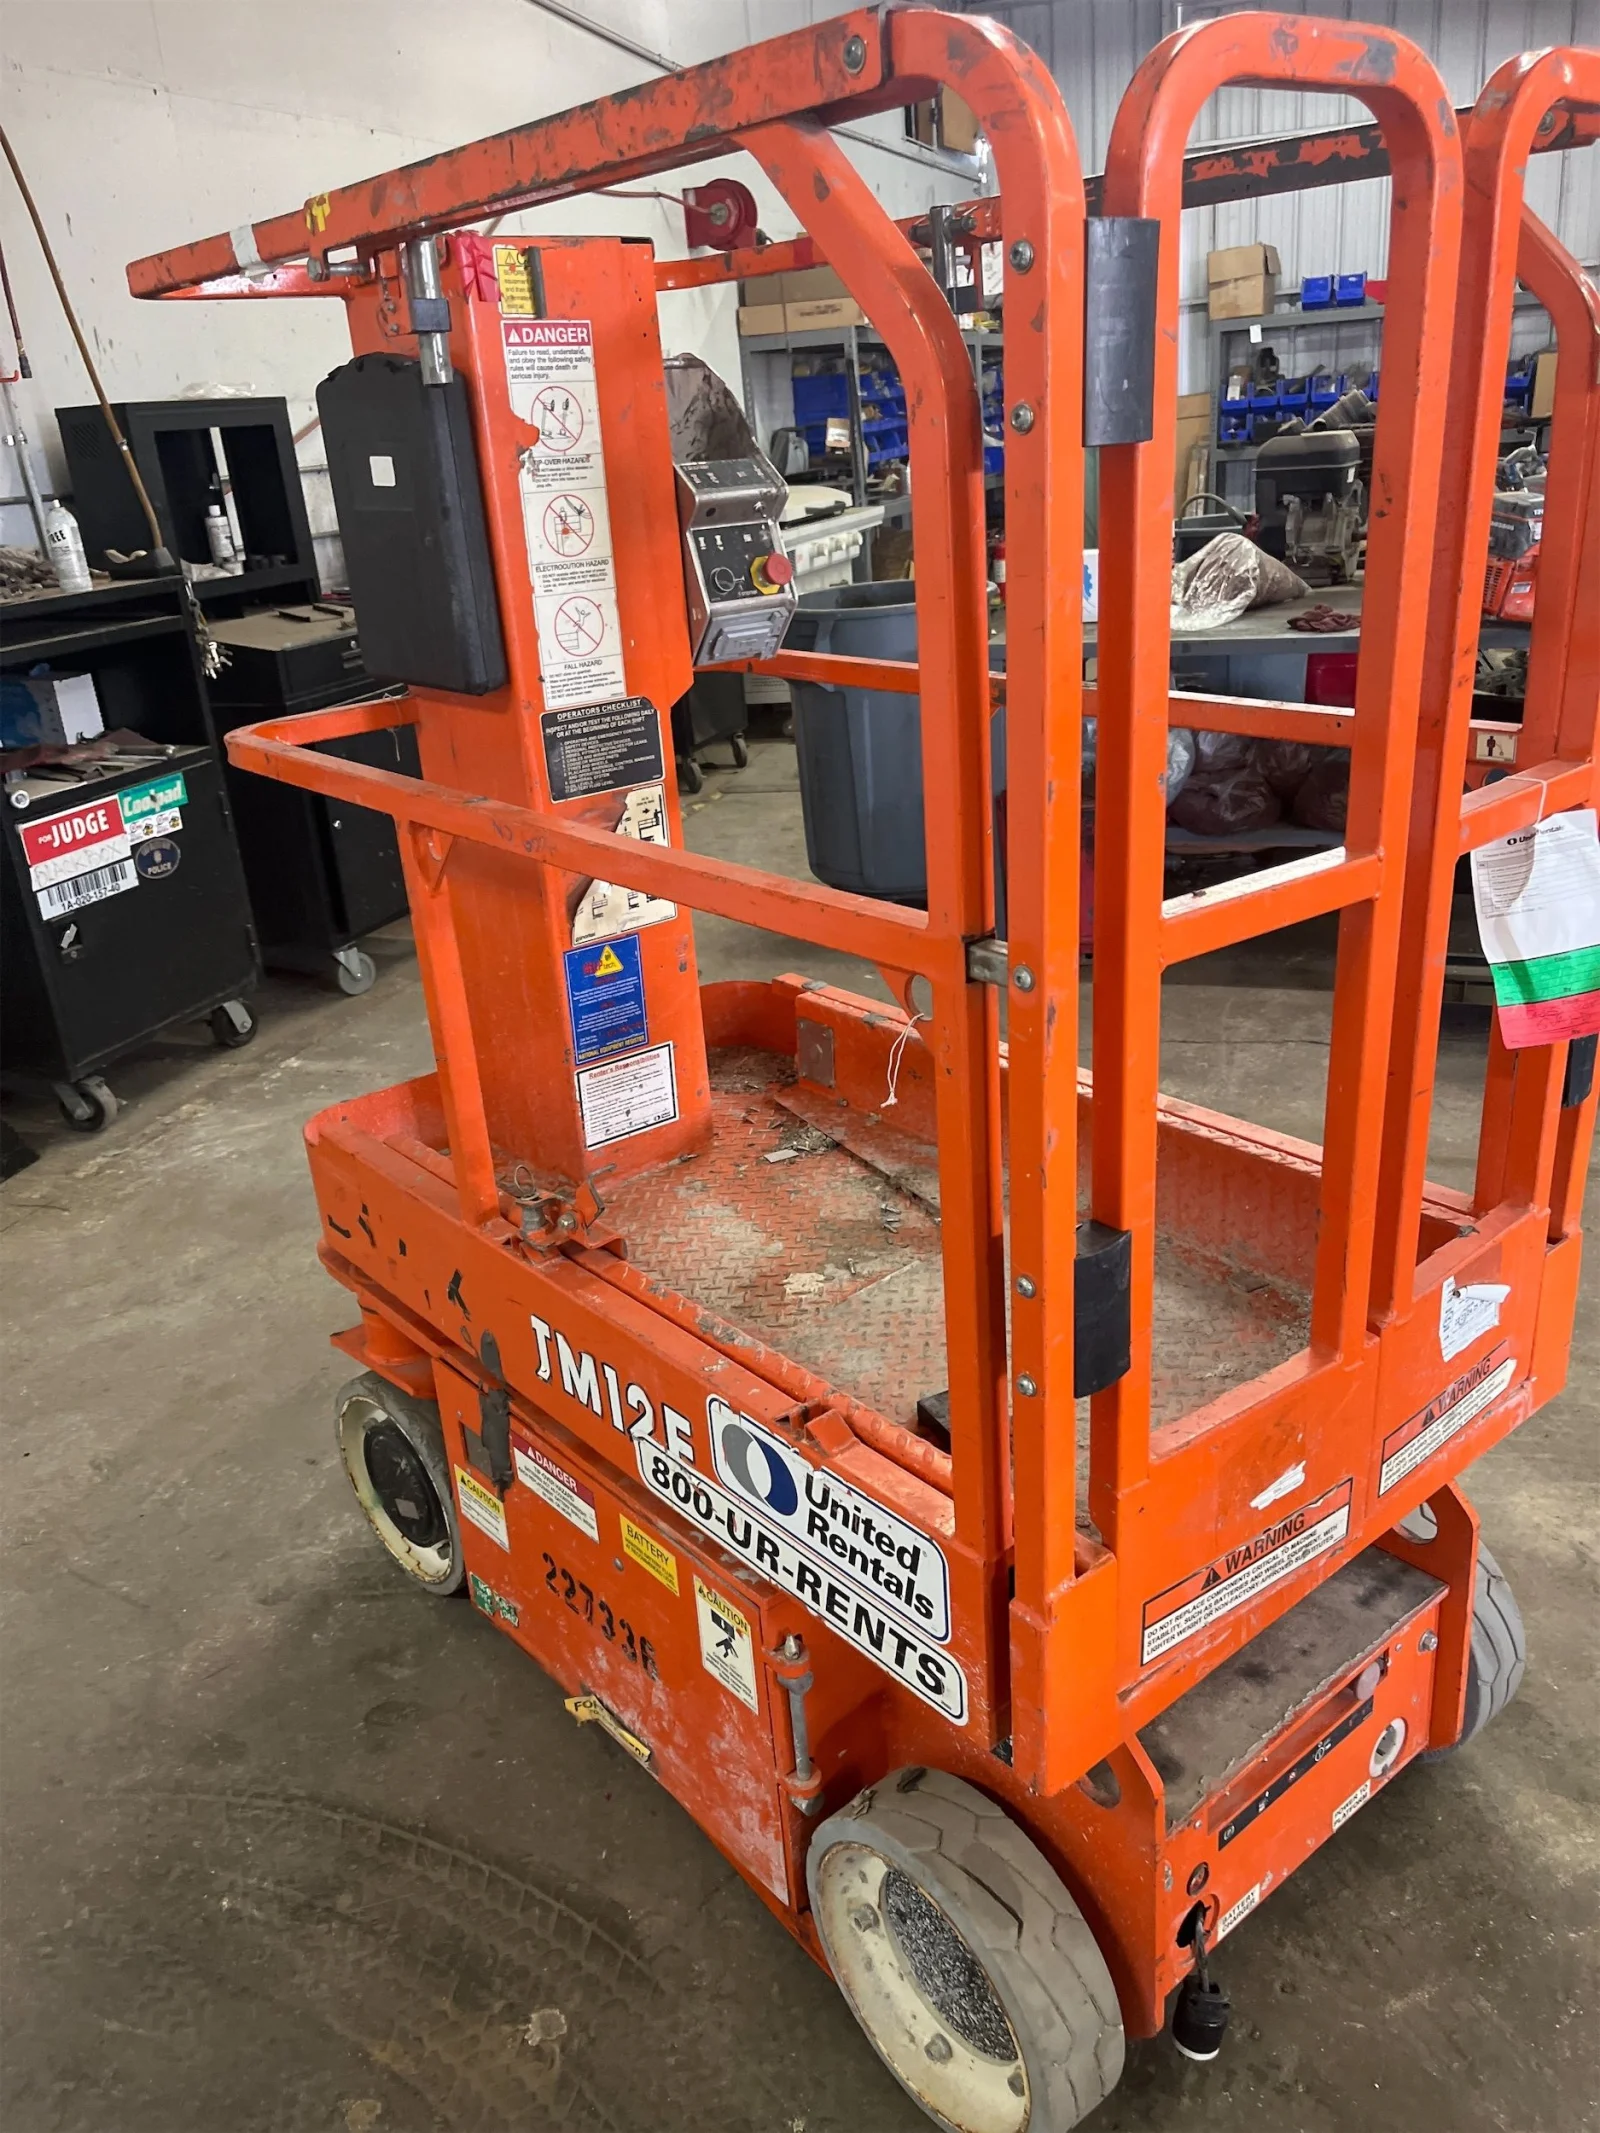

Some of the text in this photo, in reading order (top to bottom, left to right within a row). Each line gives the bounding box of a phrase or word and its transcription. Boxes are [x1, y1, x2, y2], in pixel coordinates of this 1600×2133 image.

[522, 328, 588, 343] DANGER
[535, 559, 609, 573] ELECTROCUTION HAZARD
[579, 659, 603, 668] HAZARD
[546, 725, 568, 734] INSPECT
[568, 722, 587, 730] AND/OR
[612, 712, 640, 721] FOLLOWING
[557, 700, 641, 720] OPERATORS CHECKLIST
[583, 723, 609, 733] BEGINNING
[38, 834, 52, 844] FOR
[51, 809, 109, 848] JUDGE
[148, 862, 172, 875] POLICE
[62, 883, 121, 911] 1A-020-157-40
[589, 1066, 613, 1080] Renter's
[1438, 1358, 1490, 1413] WARNING
[535, 1450, 578, 1492] DANGER
[466, 1480, 500, 1513] CAUTION
[804, 1471, 920, 1576] United
[627, 1524, 669, 1565] BATTERY
[1225, 1514, 1305, 1573] WARNING
[652, 1456, 947, 1697] 800-UR-RENTS
[807, 1510, 934, 1622] Rentals
[1184, 1608, 1203, 1625] SUCH
[1204, 1602, 1213, 1613] AS
[1214, 1579, 1249, 1606] BATTERIES
[1251, 1570, 1263, 1583] AND
[1265, 1557, 1284, 1574] WHEEL
[1324, 1524, 1338, 1537] WITH
[1147, 1529, 1317, 1640] DO NOT REPLACE COMPONENTS CRITICAL TO MACHINE
[706, 1591, 748, 1632] CAUTION
[1146, 1633, 1176, 1657] LIGHTER
[1177, 1616, 1202, 1638] WEIGHT
[1203, 1609, 1213, 1621] OR
[1215, 1581, 1259, 1614] NON-FACTORY
[1261, 1559, 1293, 1585] APPROVED
[1333, 1792, 1368, 1826] PLATFORM
[1334, 1784, 1368, 1818] POWER TO
[1221, 1891, 1256, 1925] BATTERY
[1222, 1900, 1256, 1932] CHARGER
